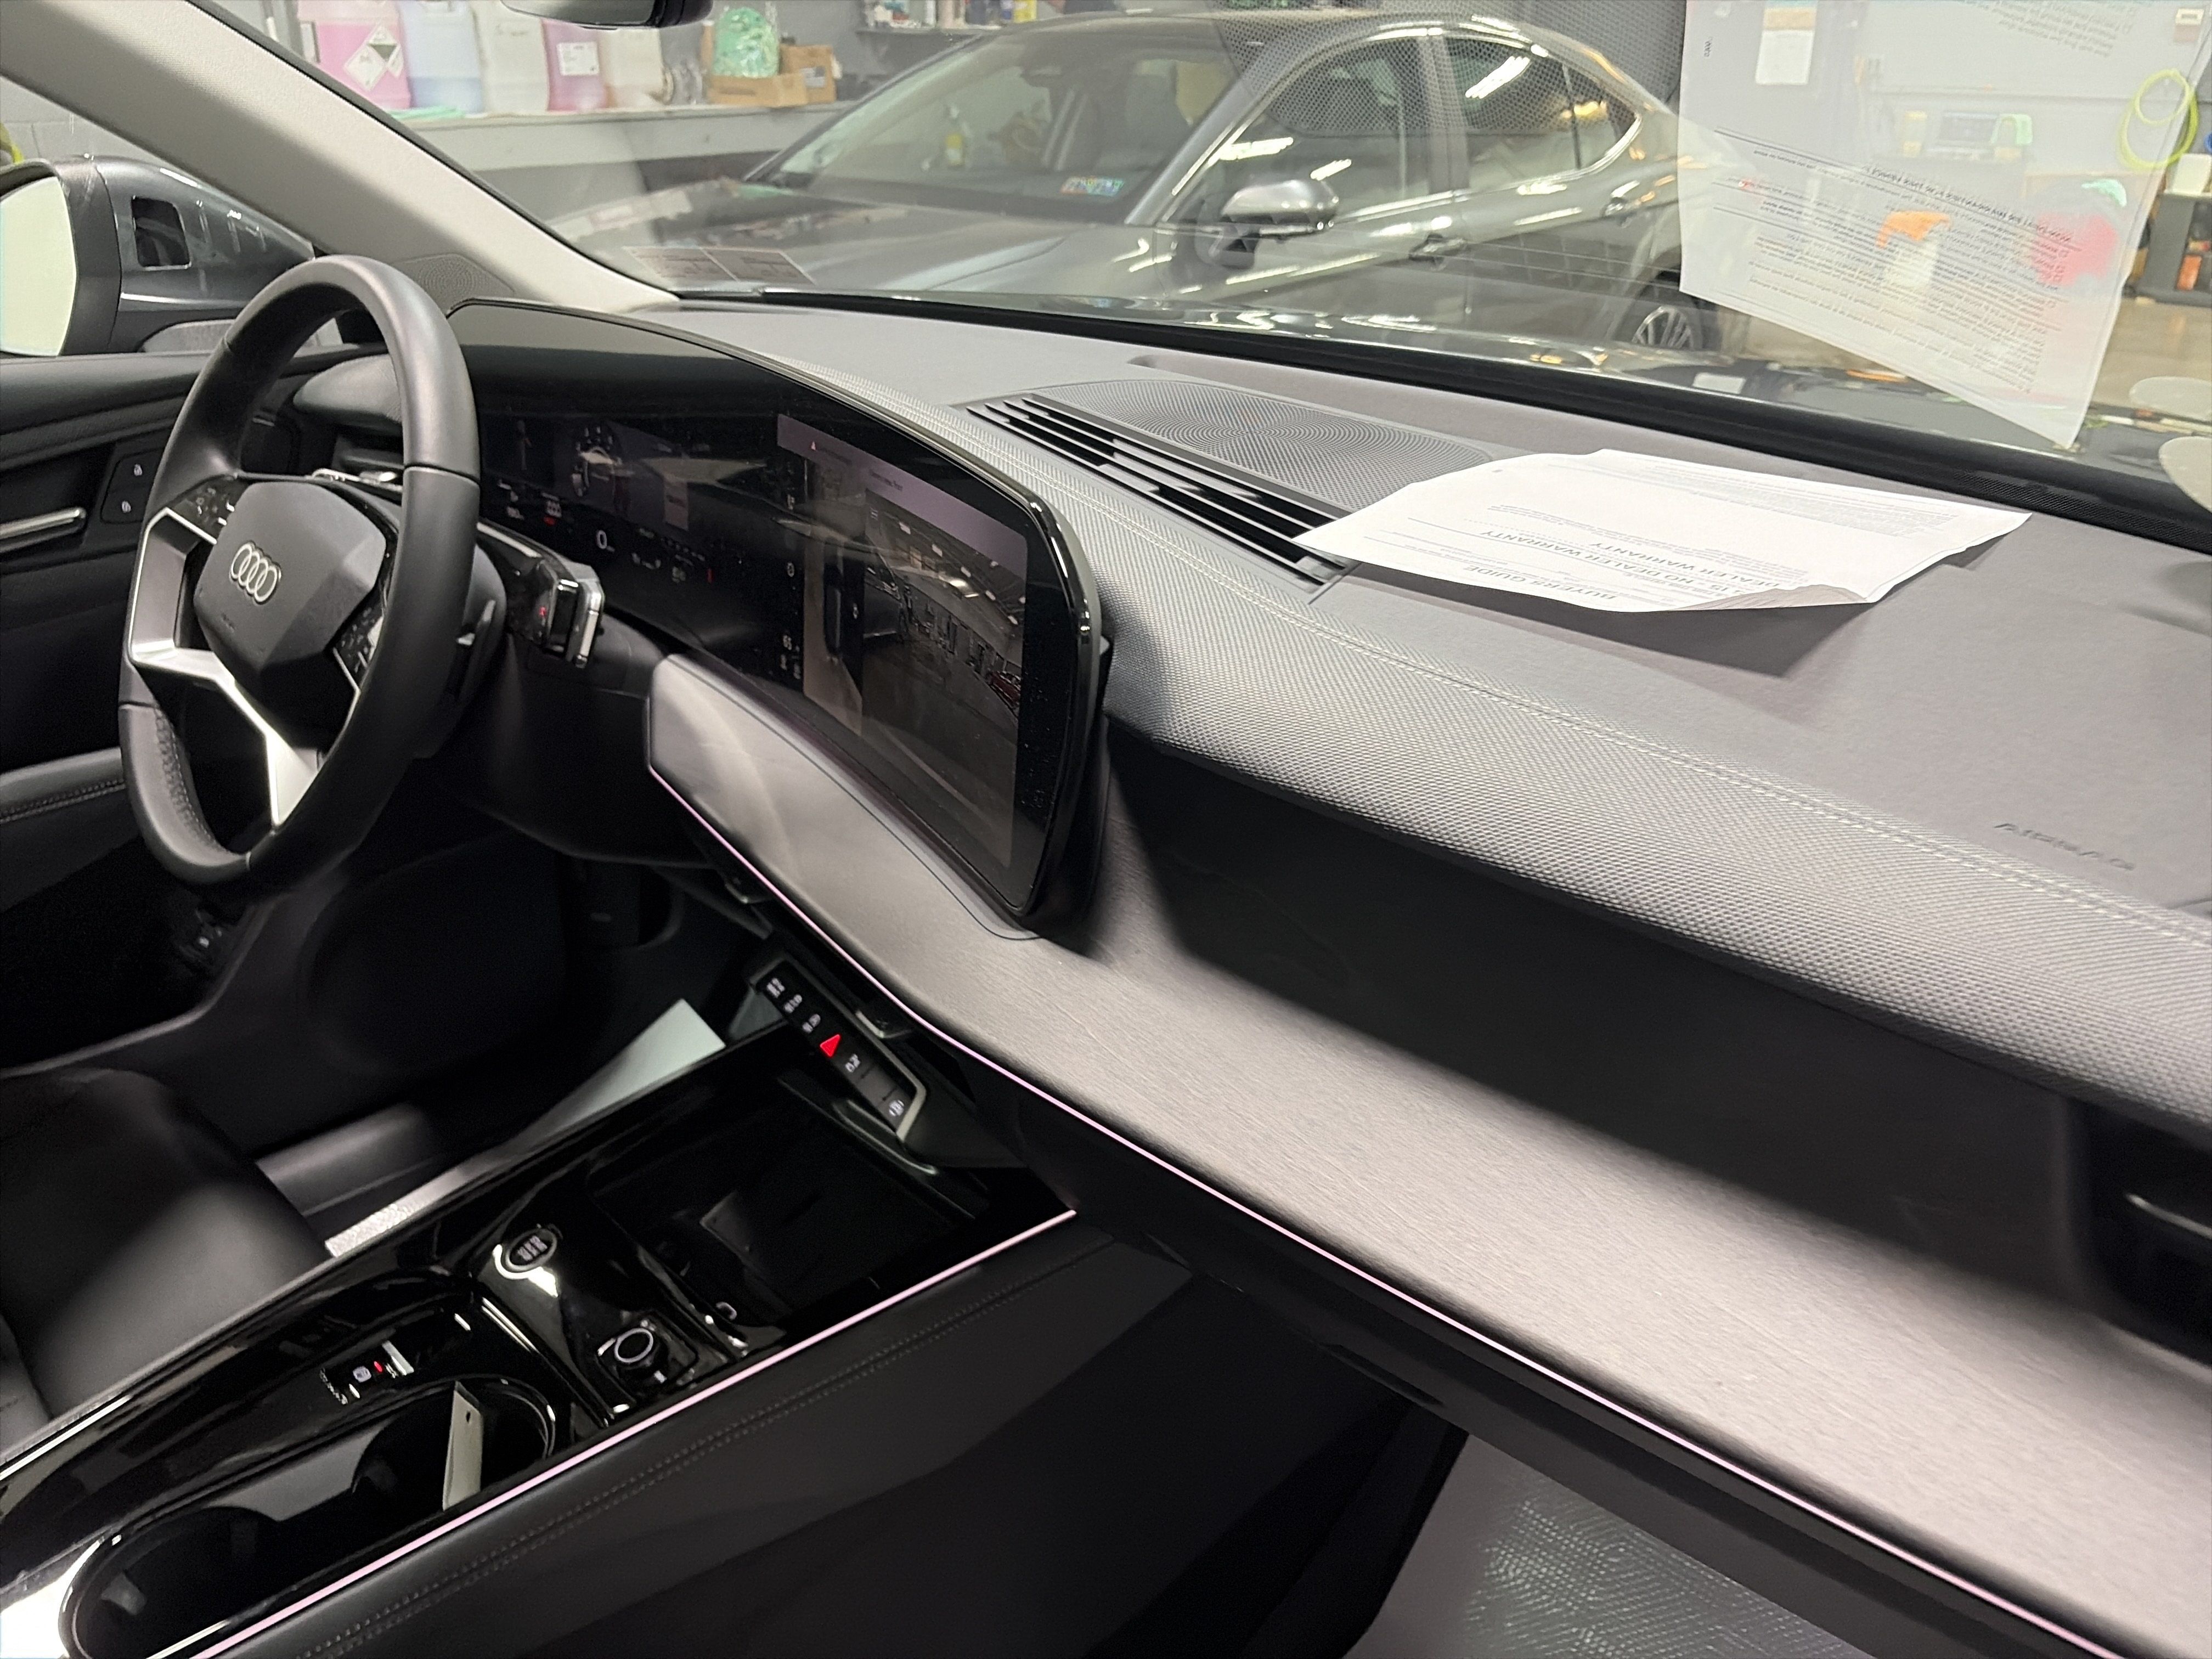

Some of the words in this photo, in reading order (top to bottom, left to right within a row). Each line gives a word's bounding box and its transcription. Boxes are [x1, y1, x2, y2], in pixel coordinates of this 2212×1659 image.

[1480, 531, 1581, 556] WARRANTY
[1585, 554, 1661, 577] DEALER
[1589, 542, 1695, 571] WARRANTY
[1463, 565, 1526, 582] GUIDE
[1664, 574, 1694, 584] NO
[1700, 568, 1781, 588] DEALER
[1531, 580, 1618, 600] BUYERS
